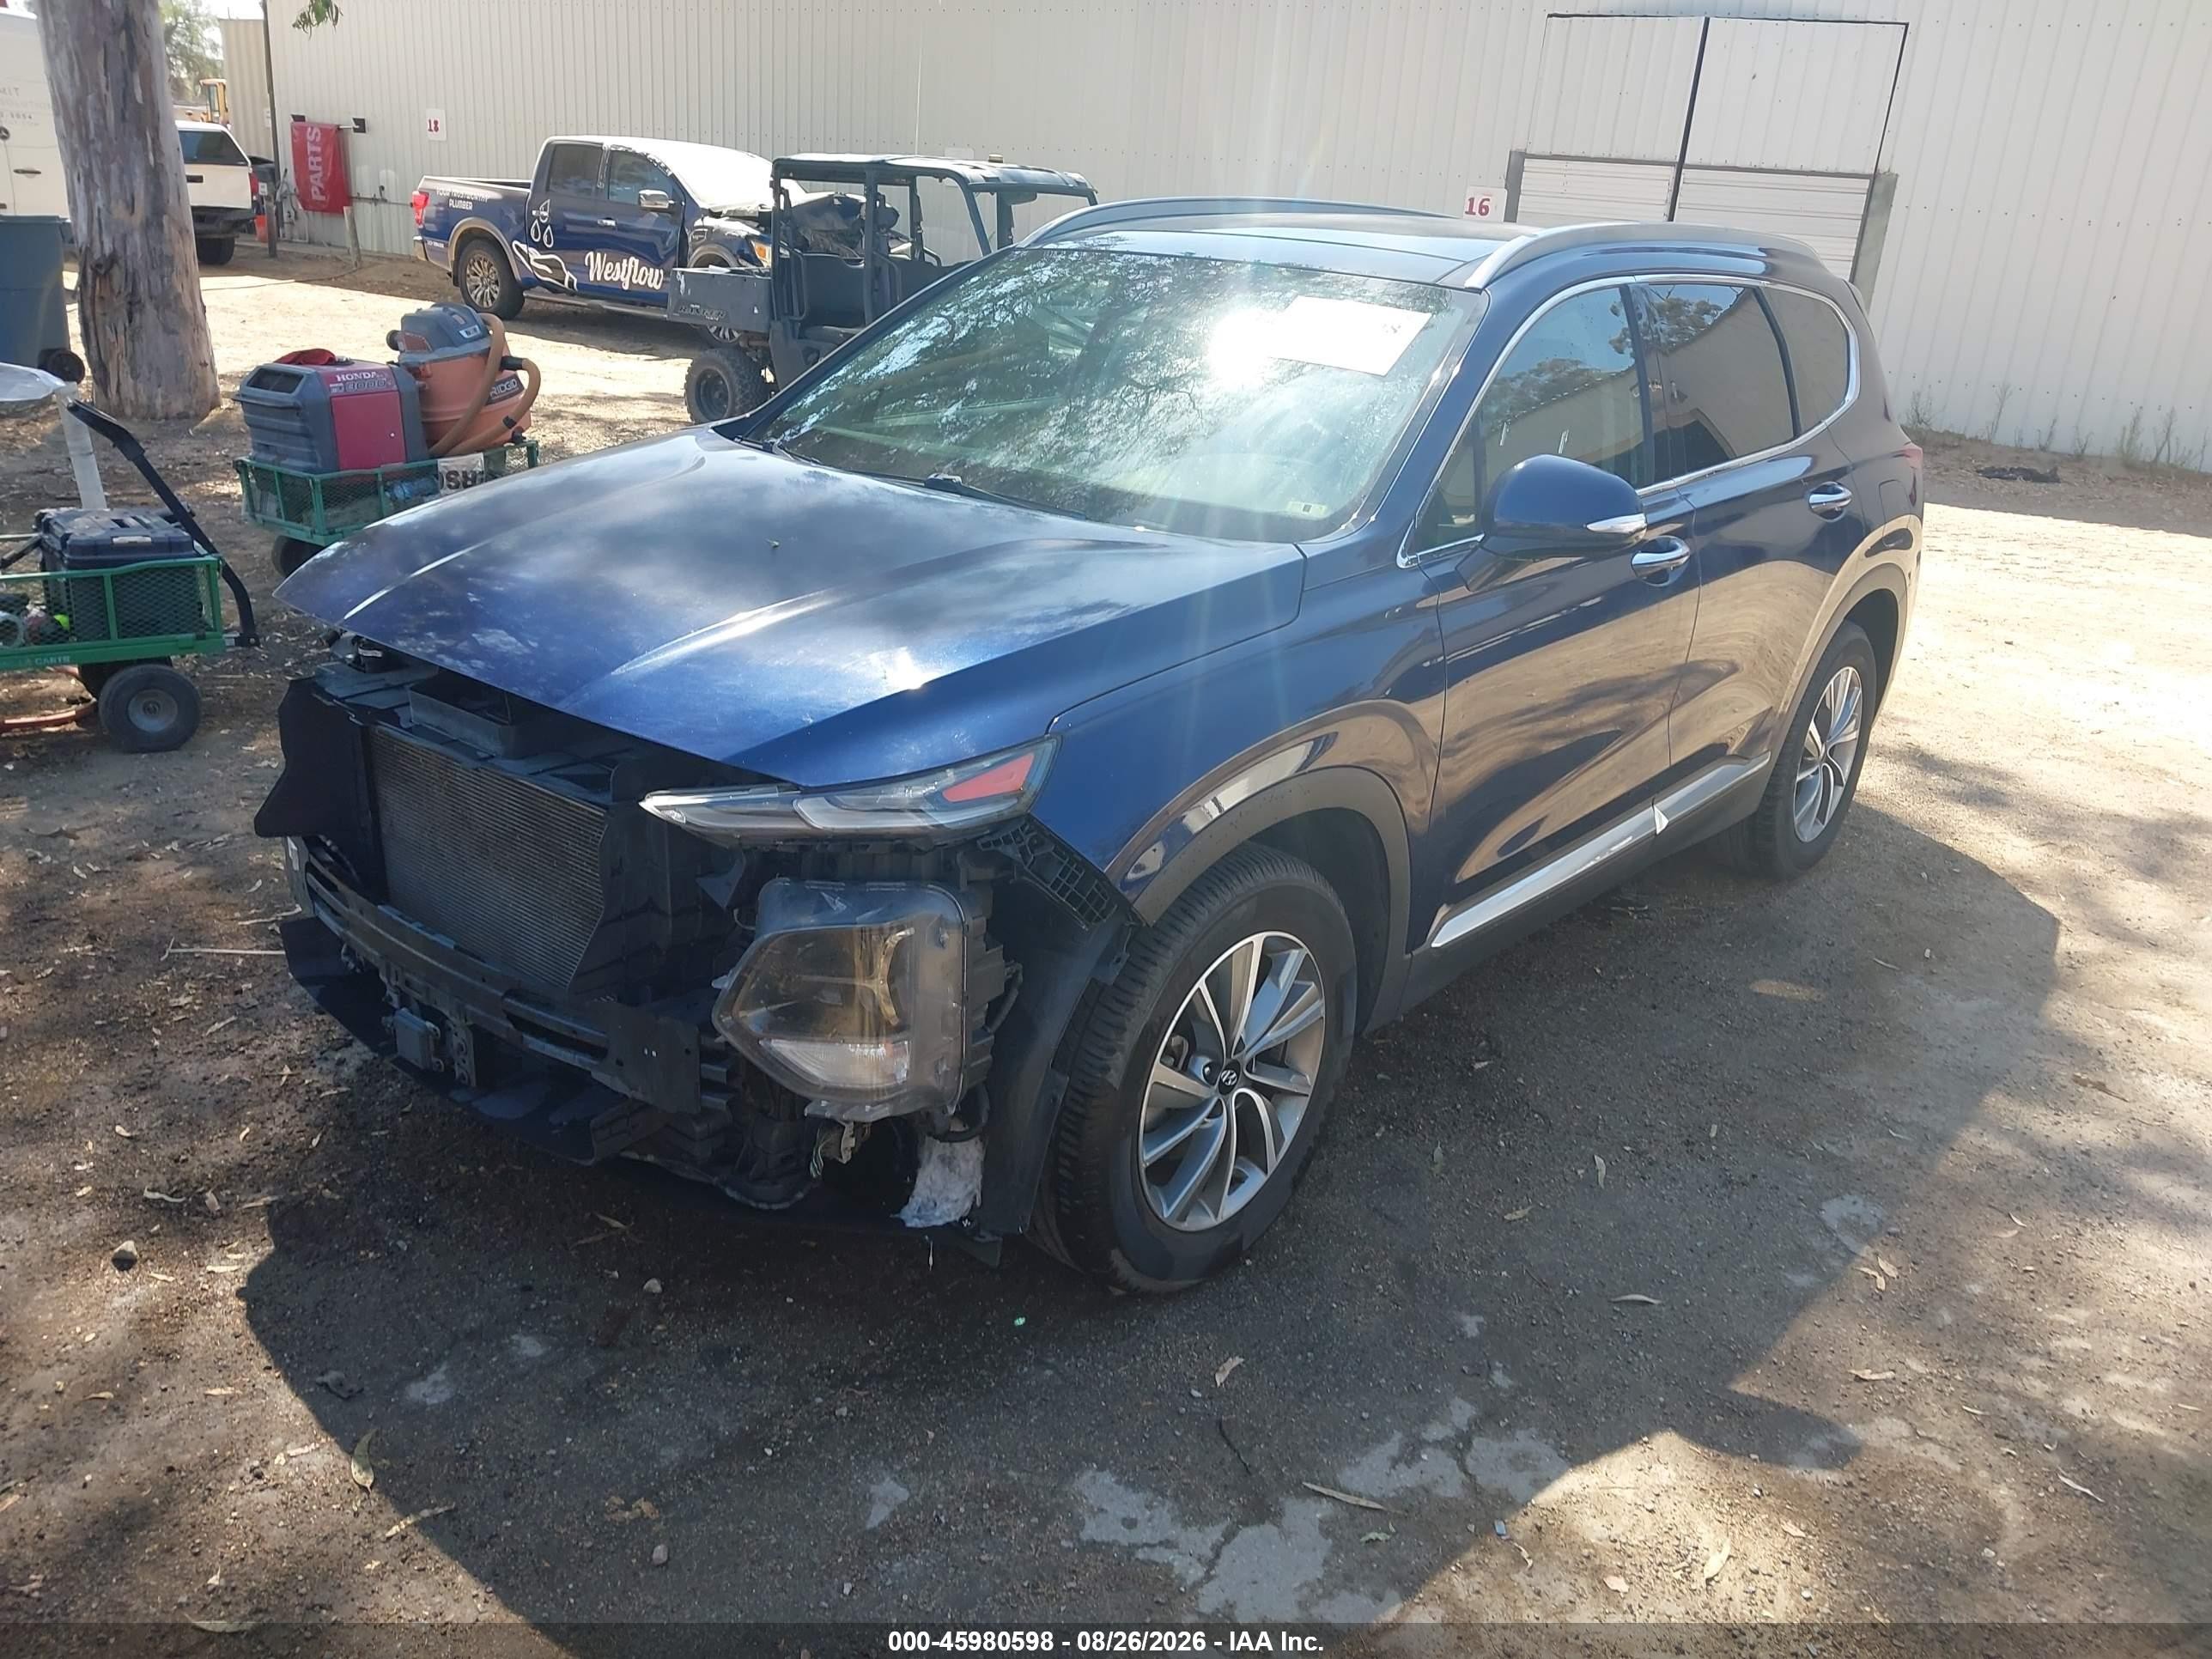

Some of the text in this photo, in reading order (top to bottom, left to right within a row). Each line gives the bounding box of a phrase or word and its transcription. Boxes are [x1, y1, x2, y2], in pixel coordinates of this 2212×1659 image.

[428, 118, 440, 133] 18
[307, 126, 327, 202] PARTS
[448, 198, 473, 211] PLUMBER
[1464, 197, 1491, 216] 16
[584, 250, 665, 291] Westflow
[336, 371, 378, 382] HONDA
[489, 378, 518, 398] RIDGID
